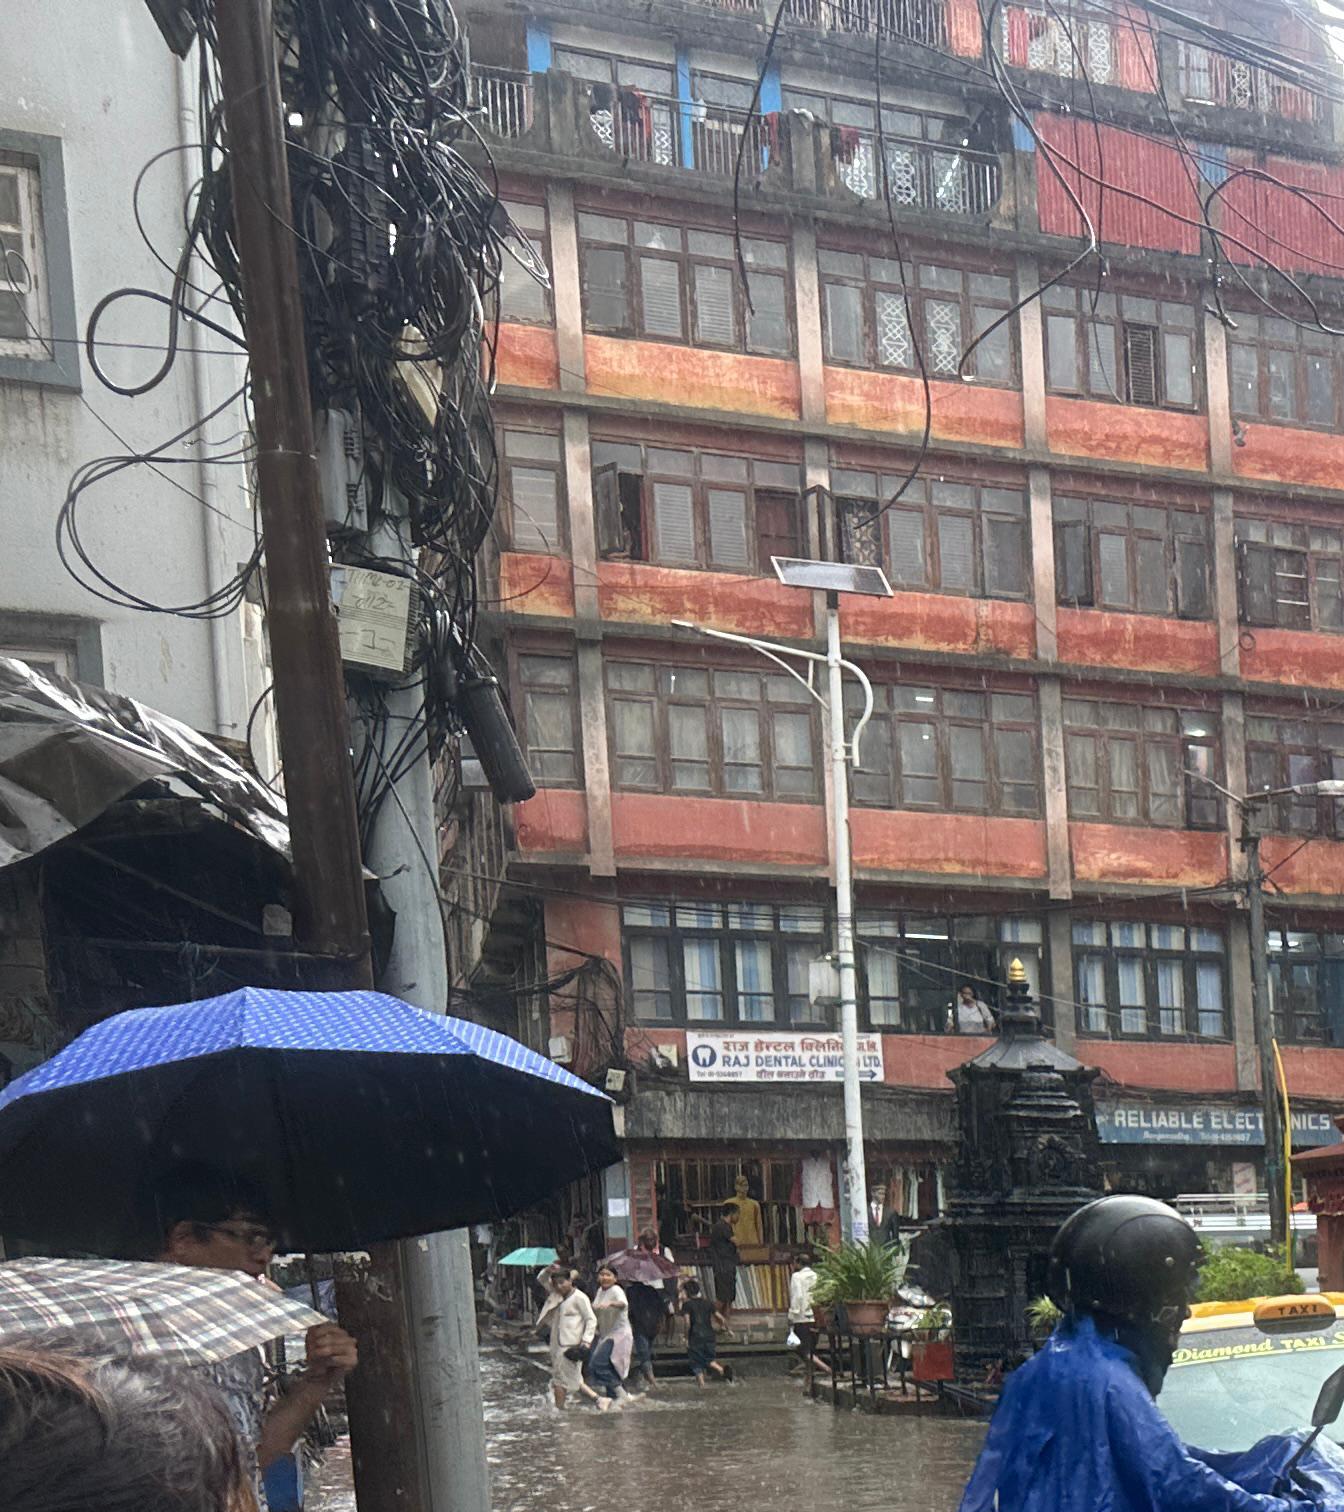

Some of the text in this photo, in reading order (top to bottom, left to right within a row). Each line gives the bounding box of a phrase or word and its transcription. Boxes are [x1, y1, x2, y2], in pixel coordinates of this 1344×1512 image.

[722, 1055, 750, 1068] RAJ
[755, 1055, 805, 1068] DENTAL
[809, 1055, 844, 1068] CLINIC
[1114, 1109, 1330, 1131] RELIABLE ELECTNICS
[1278, 1304, 1317, 1316] TAXI
[1172, 1338, 1274, 1362] Diamond
[1280, 1336, 1326, 1349] TAXI
